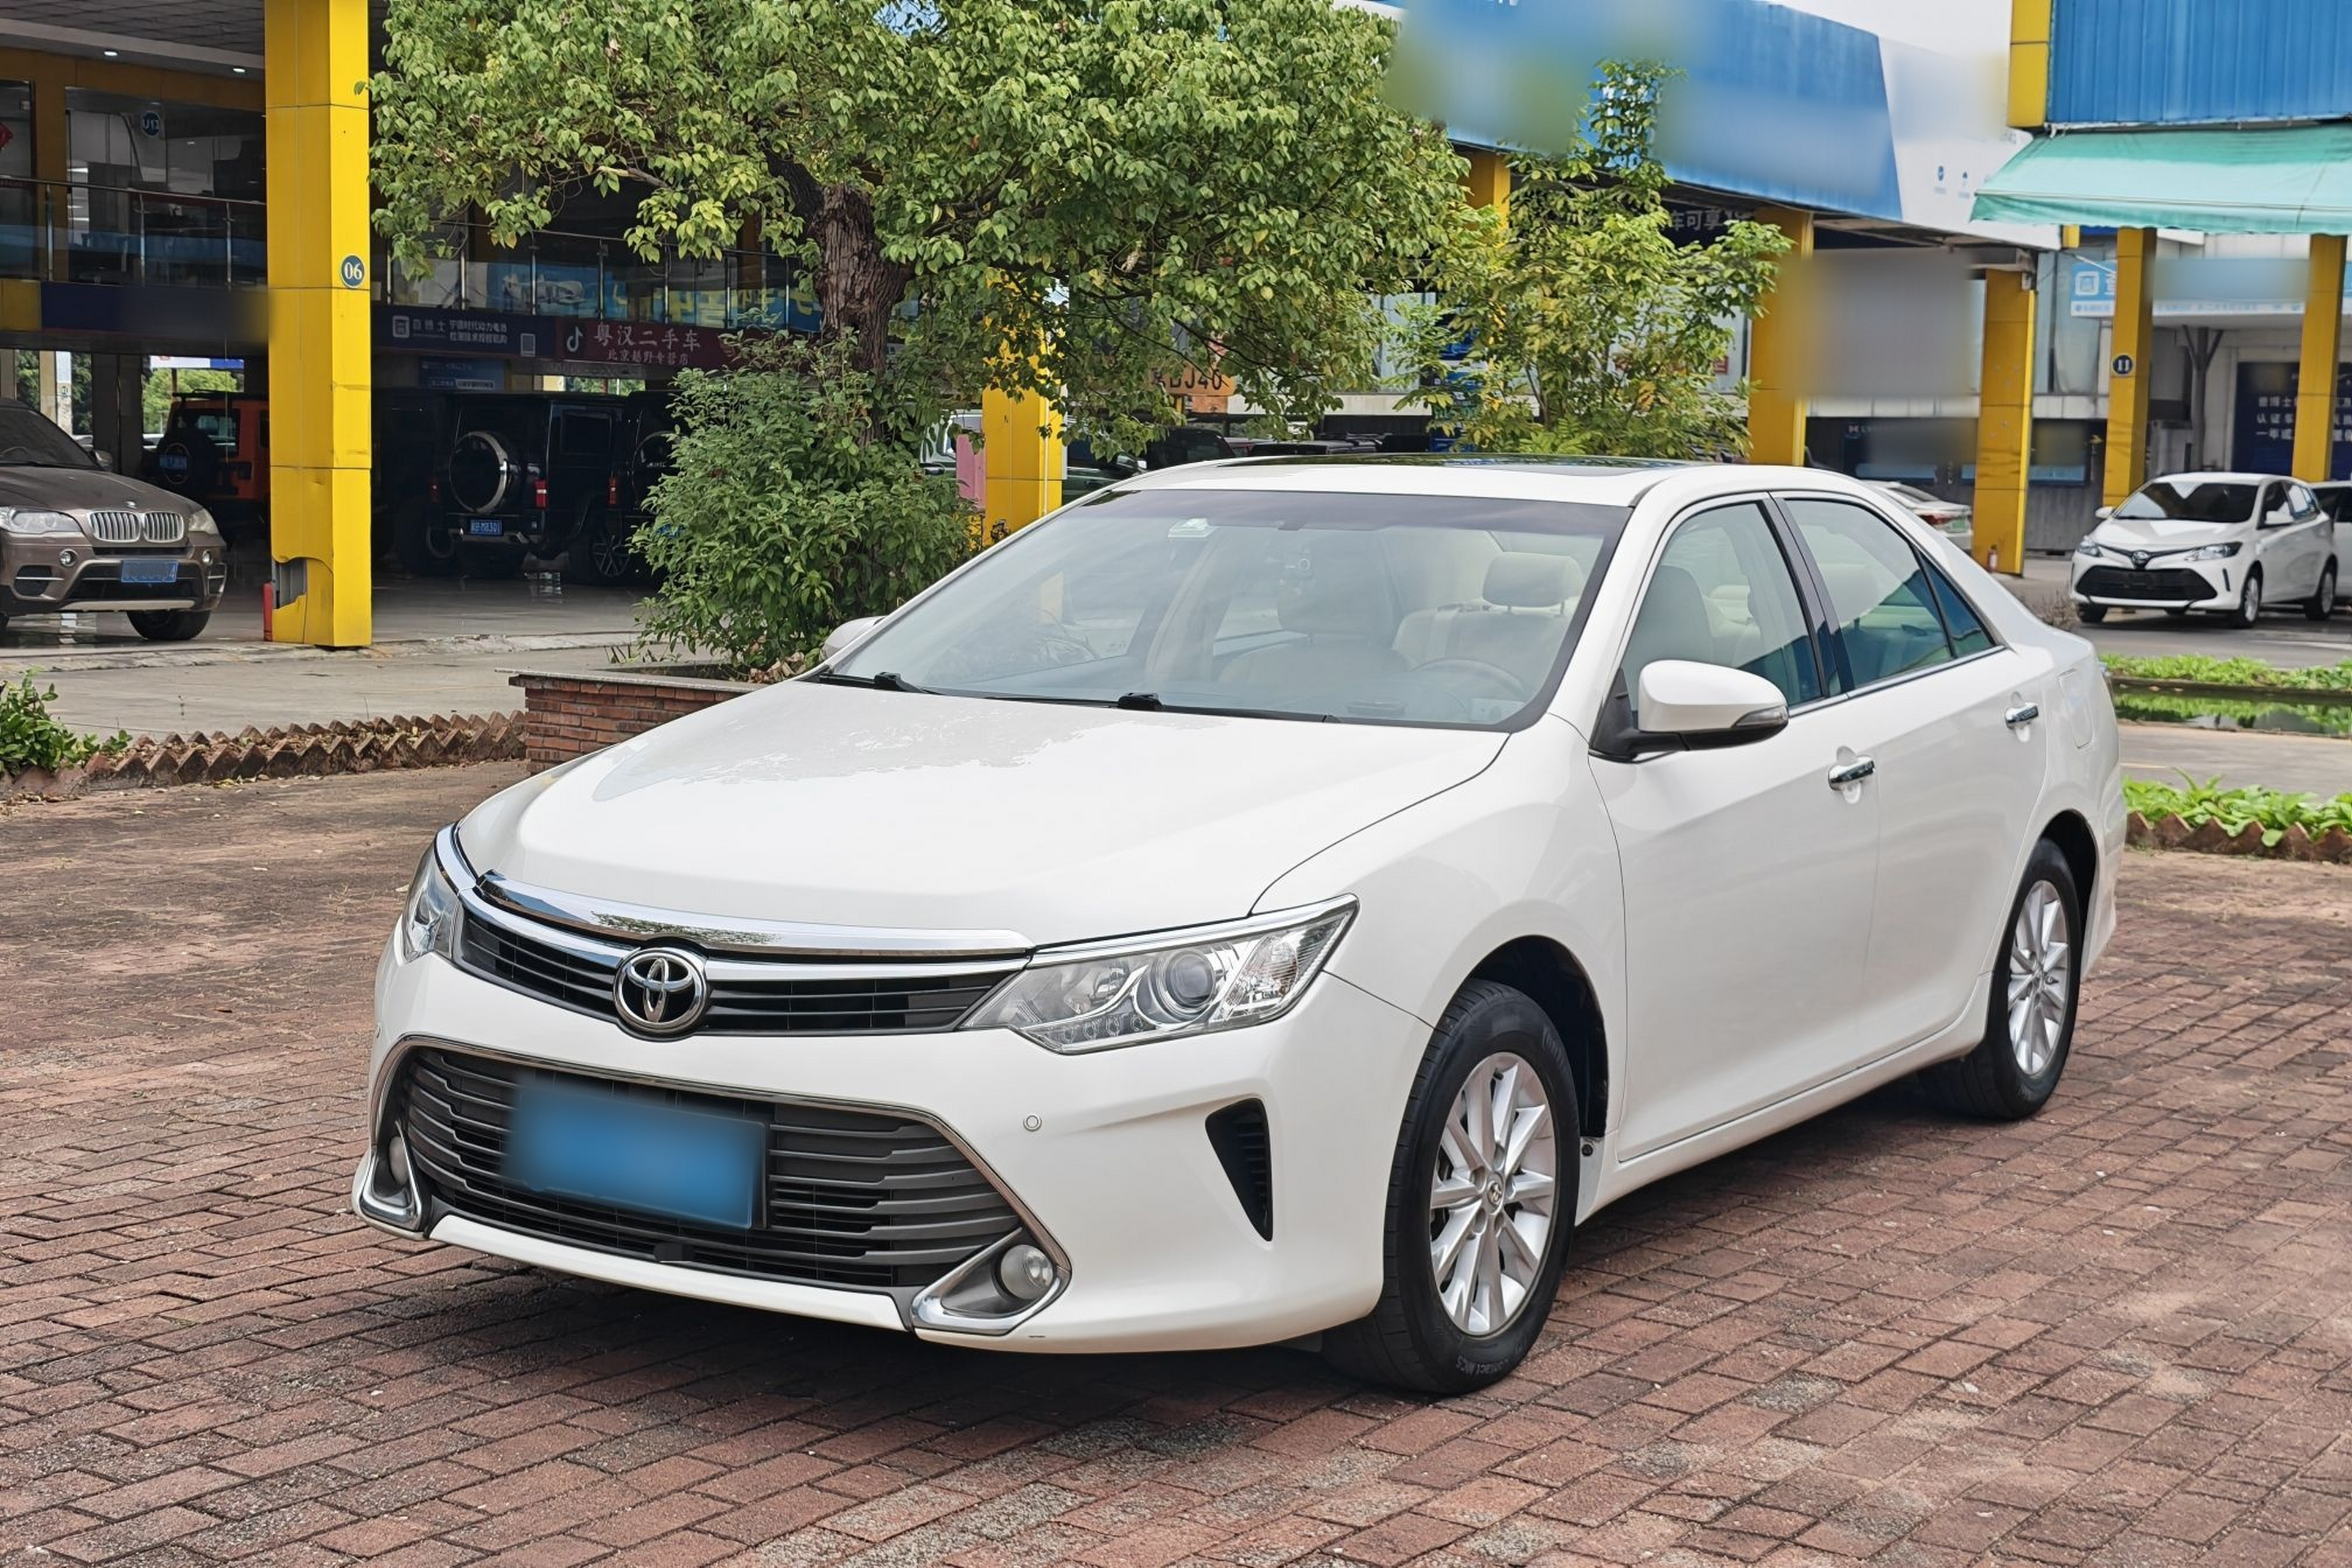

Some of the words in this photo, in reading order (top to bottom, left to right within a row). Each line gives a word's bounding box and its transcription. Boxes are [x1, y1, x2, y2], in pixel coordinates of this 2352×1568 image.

[344, 262, 363, 280] 06
[594, 323, 701, 352] 粤汉二手车
[606, 350, 689, 366] 北京越野专营店
[2118, 359, 2130, 371] 11
